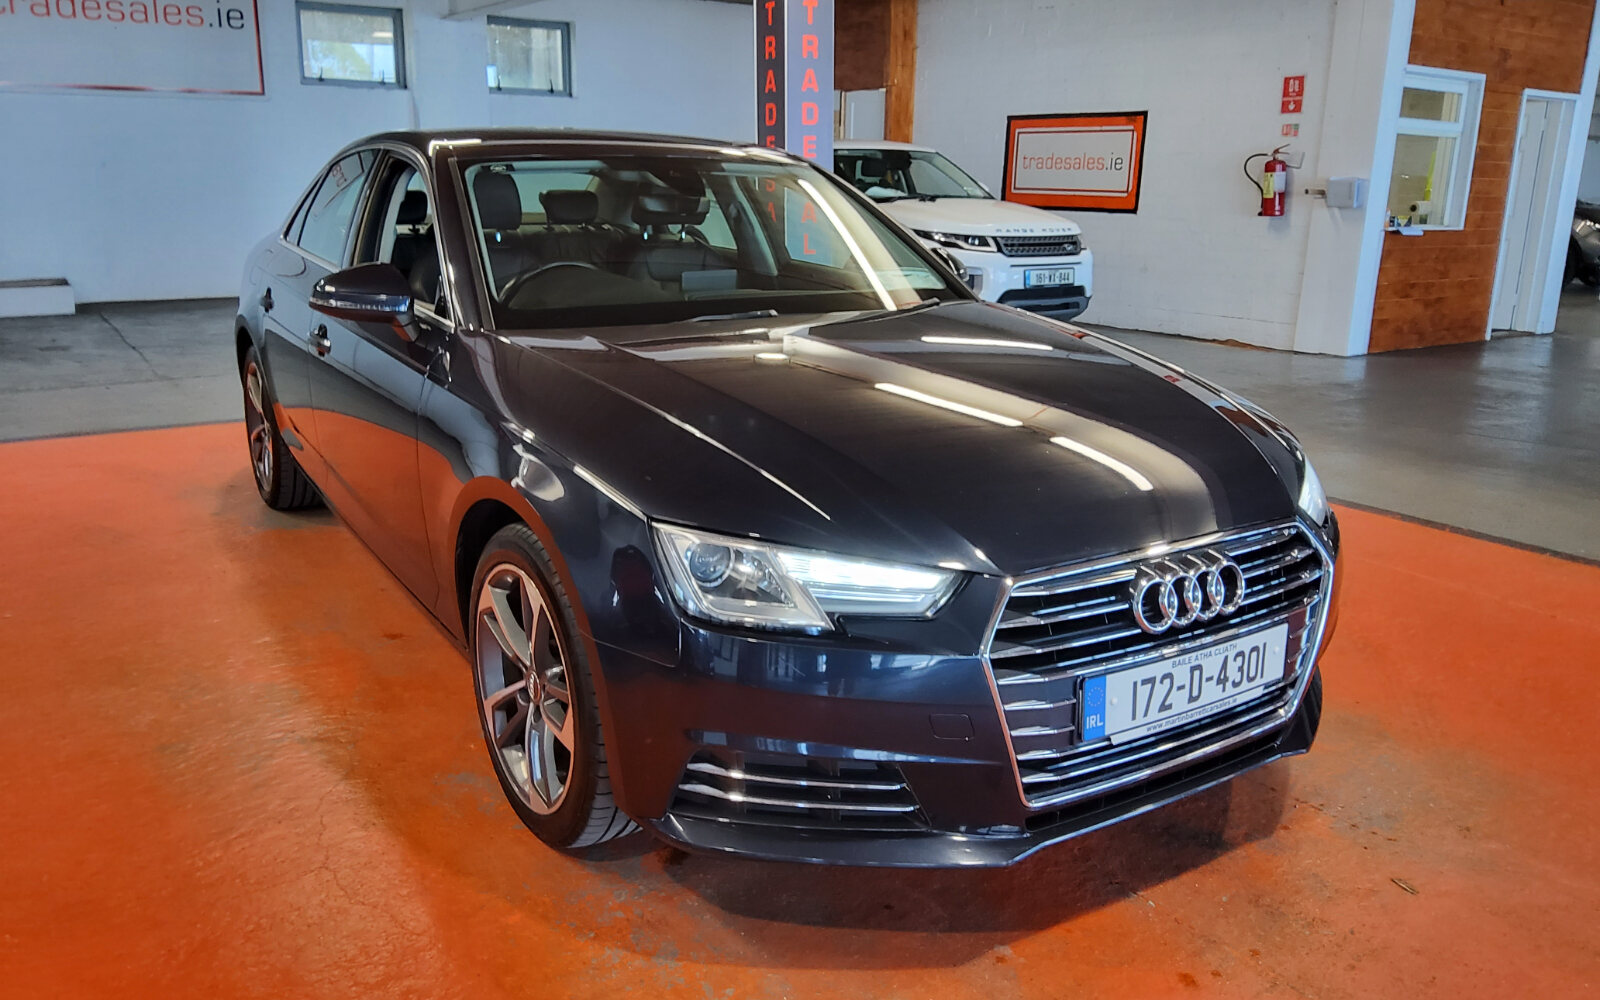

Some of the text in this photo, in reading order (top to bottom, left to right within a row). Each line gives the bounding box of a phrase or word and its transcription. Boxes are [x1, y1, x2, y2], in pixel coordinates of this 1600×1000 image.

[1022, 151, 1123, 171] tradesales.ie
[1172, 656, 1192, 669] BAILE
[1131, 642, 1267, 721] 172-D-4301
[1086, 714, 1104, 730] IRL
